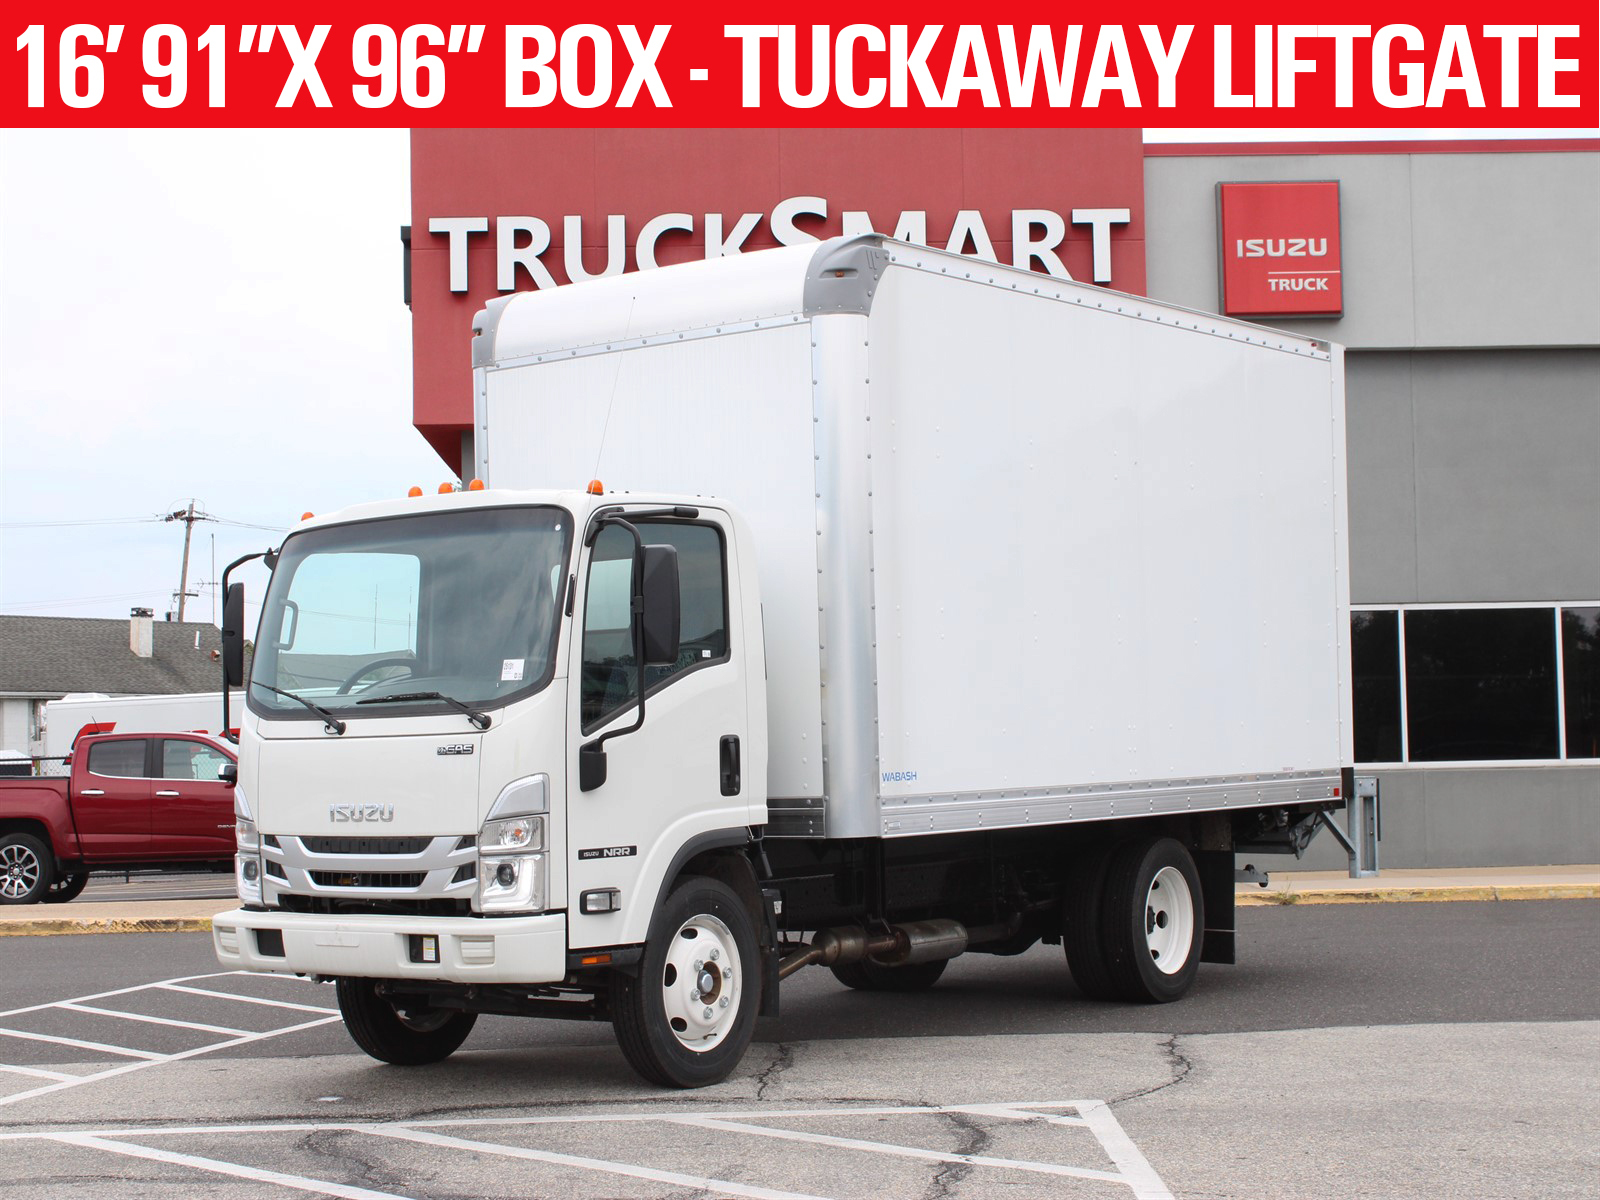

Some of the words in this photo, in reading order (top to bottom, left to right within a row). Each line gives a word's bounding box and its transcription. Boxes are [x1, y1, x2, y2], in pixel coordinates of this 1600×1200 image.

[1237, 238, 1328, 258] ISUZU
[1268, 278, 1329, 291] TRUCK
[446, 744, 473, 754] GAS
[882, 771, 917, 782] WABASH
[329, 803, 394, 822] ISUZU
[603, 847, 631, 857] NRR
